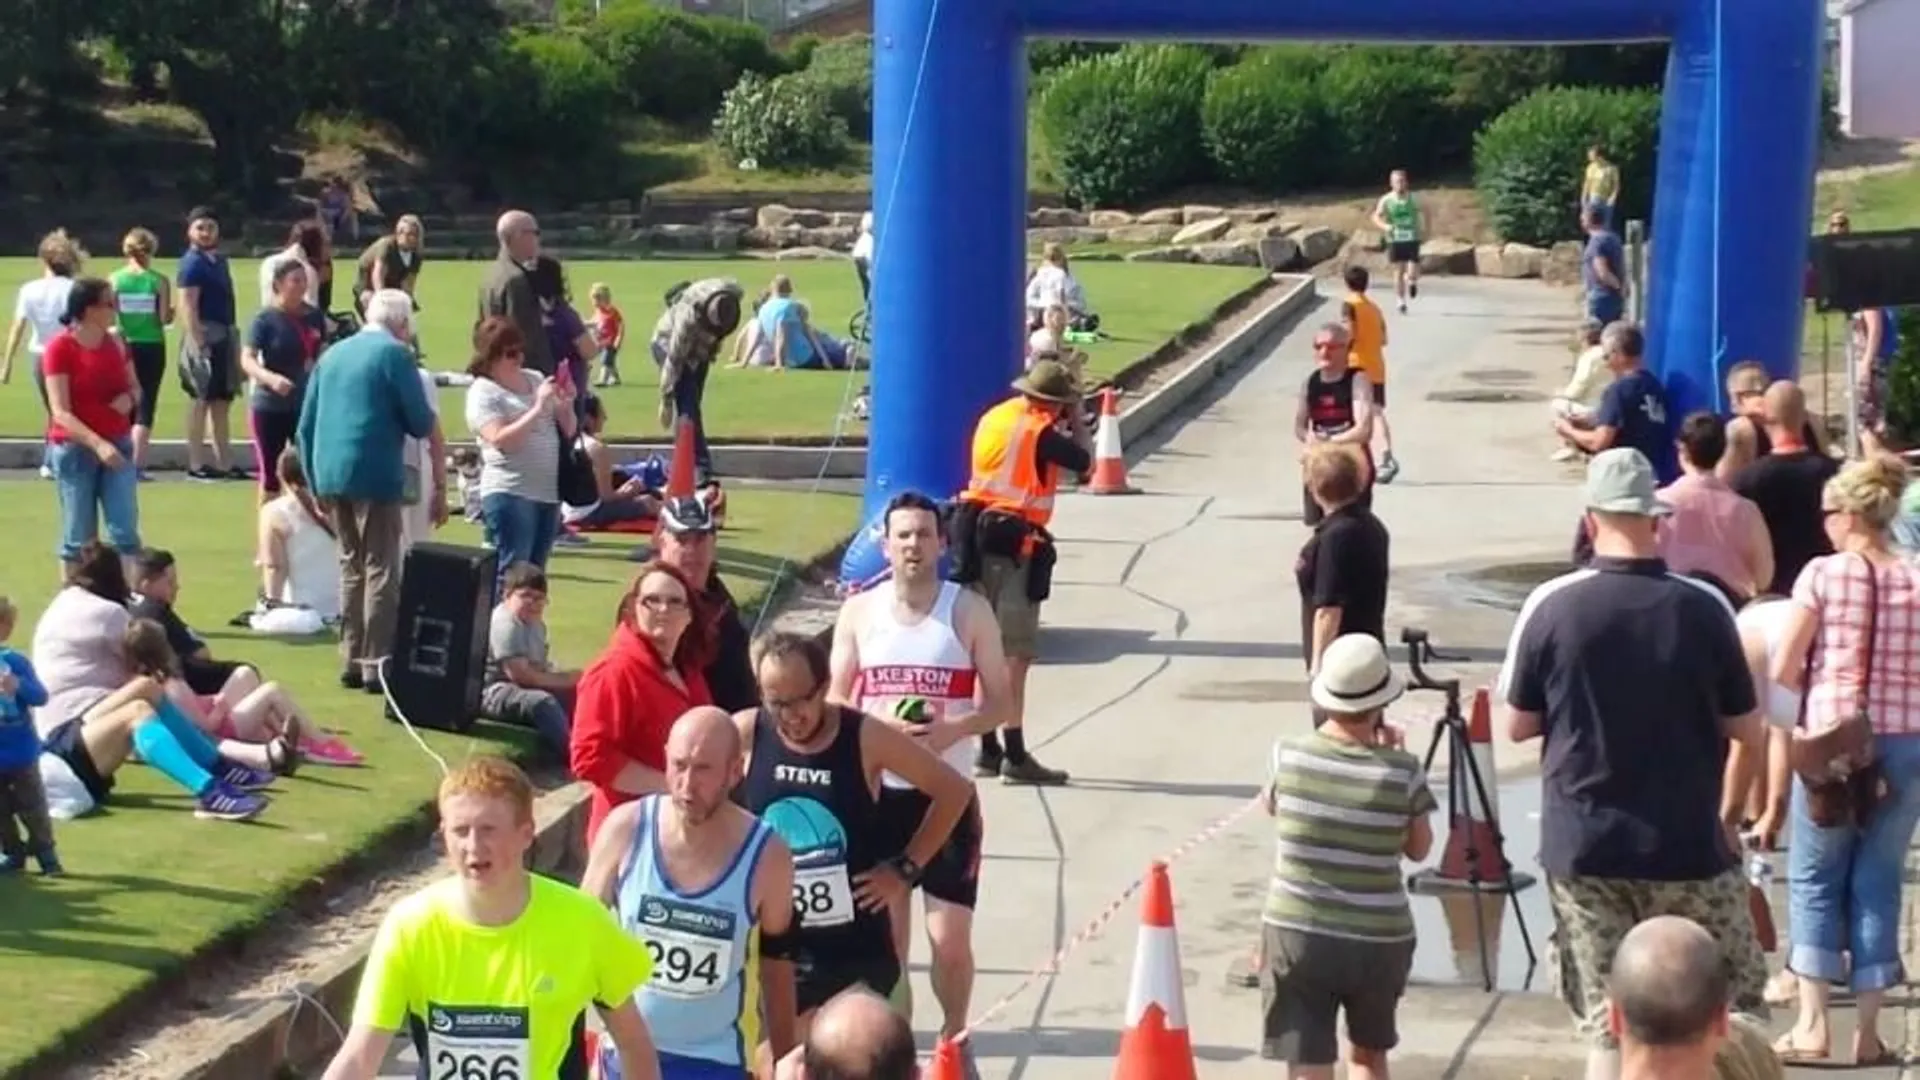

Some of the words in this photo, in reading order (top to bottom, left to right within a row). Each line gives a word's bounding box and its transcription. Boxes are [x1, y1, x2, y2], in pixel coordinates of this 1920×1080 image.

[865, 669, 953, 684] LKESTON
[774, 764, 832, 785] STEVE
[645, 940, 720, 985] 294
[437, 1050, 520, 1080] 266
